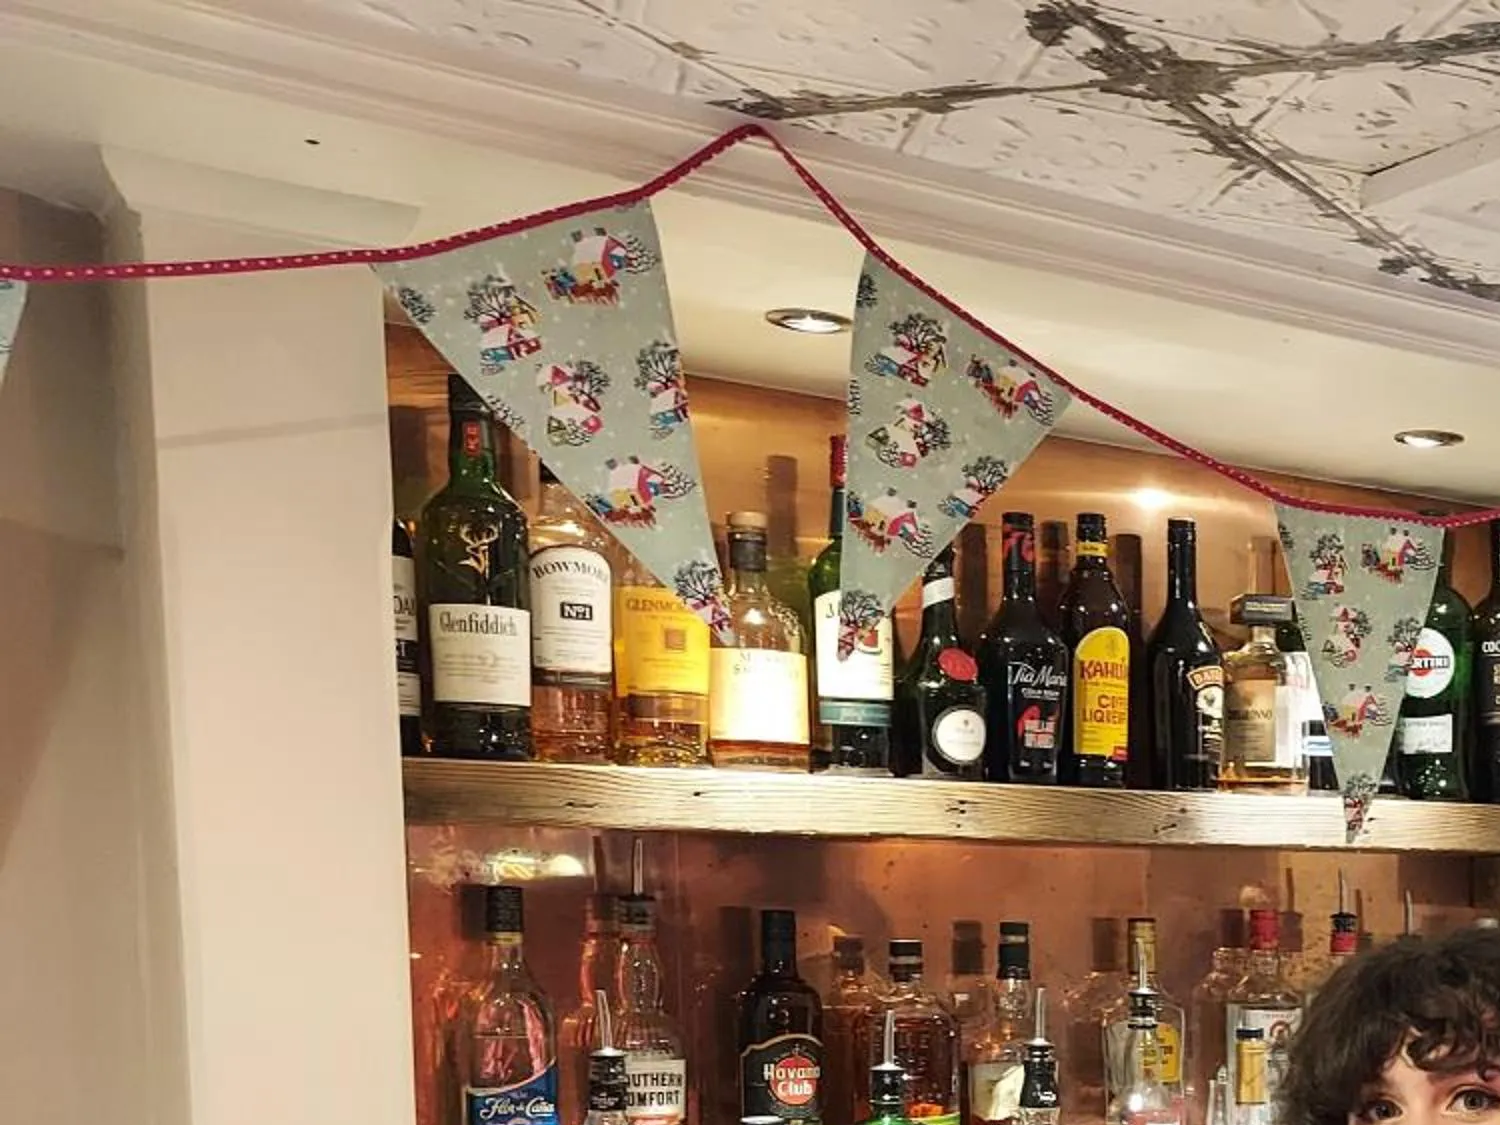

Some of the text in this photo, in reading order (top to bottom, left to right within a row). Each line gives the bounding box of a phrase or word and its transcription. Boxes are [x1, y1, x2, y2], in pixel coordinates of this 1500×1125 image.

[439, 611, 519, 637] Glenfiddich
[763, 1062, 820, 1081] Havana
[778, 1079, 814, 1096] Club
[627, 1090, 681, 1106] OMFORT
